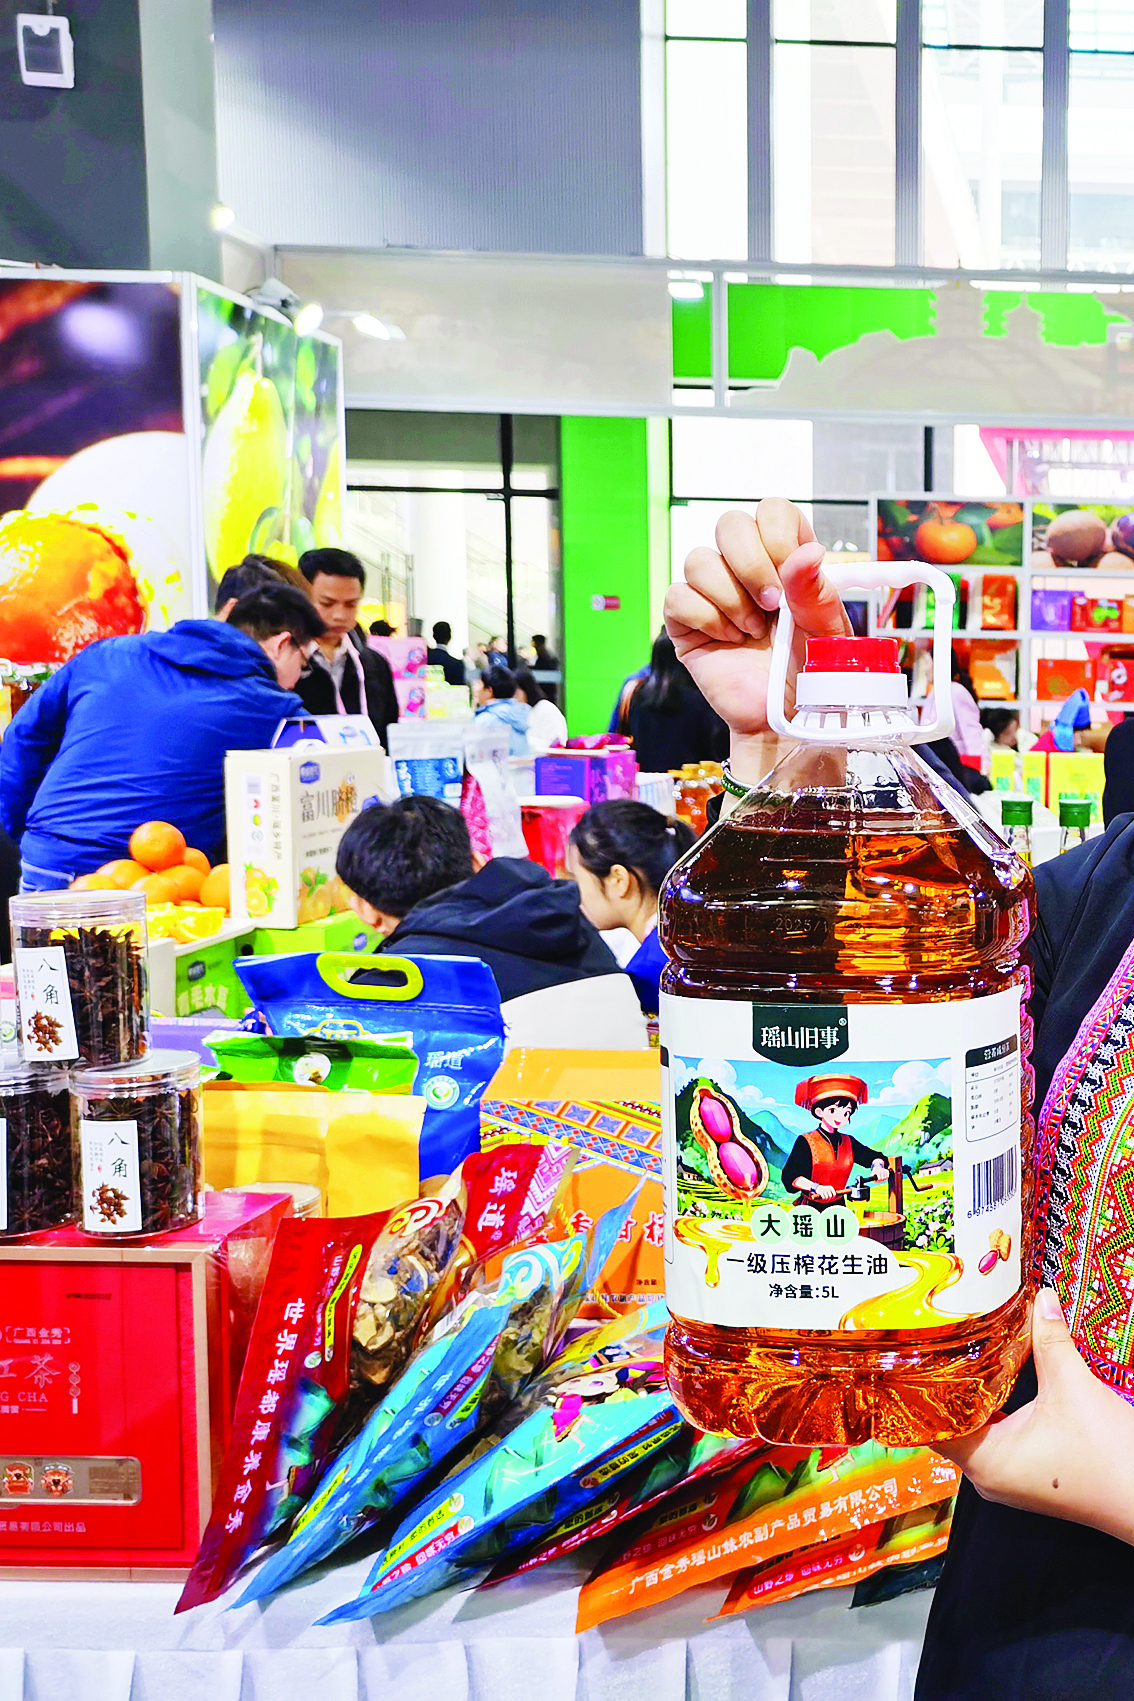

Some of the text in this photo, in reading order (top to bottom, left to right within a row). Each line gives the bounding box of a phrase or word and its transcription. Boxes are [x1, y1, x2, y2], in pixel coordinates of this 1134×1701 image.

[37, 958, 60, 1005] 八角
[761, 1026, 840, 1049] 瑶山旧事
[107, 1132, 130, 1178] 八角
[759, 1213, 846, 1238] 大瑶山
[726, 1252, 888, 1276] 一级压榨花生油
[769, 1283, 840, 1299] 净含量:5L
[13, 1327, 63, 1339] 广西金秀
[17, 1391, 49, 1402] CHA
[225, 1297, 306, 1534] 世界瑶都康养金秀
[415, 1529, 458, 1566] 回味无穷
[657, 1524, 698, 1547] 回味无穷
[753, 1552, 844, 1595] 山野之珍 回味无穷
